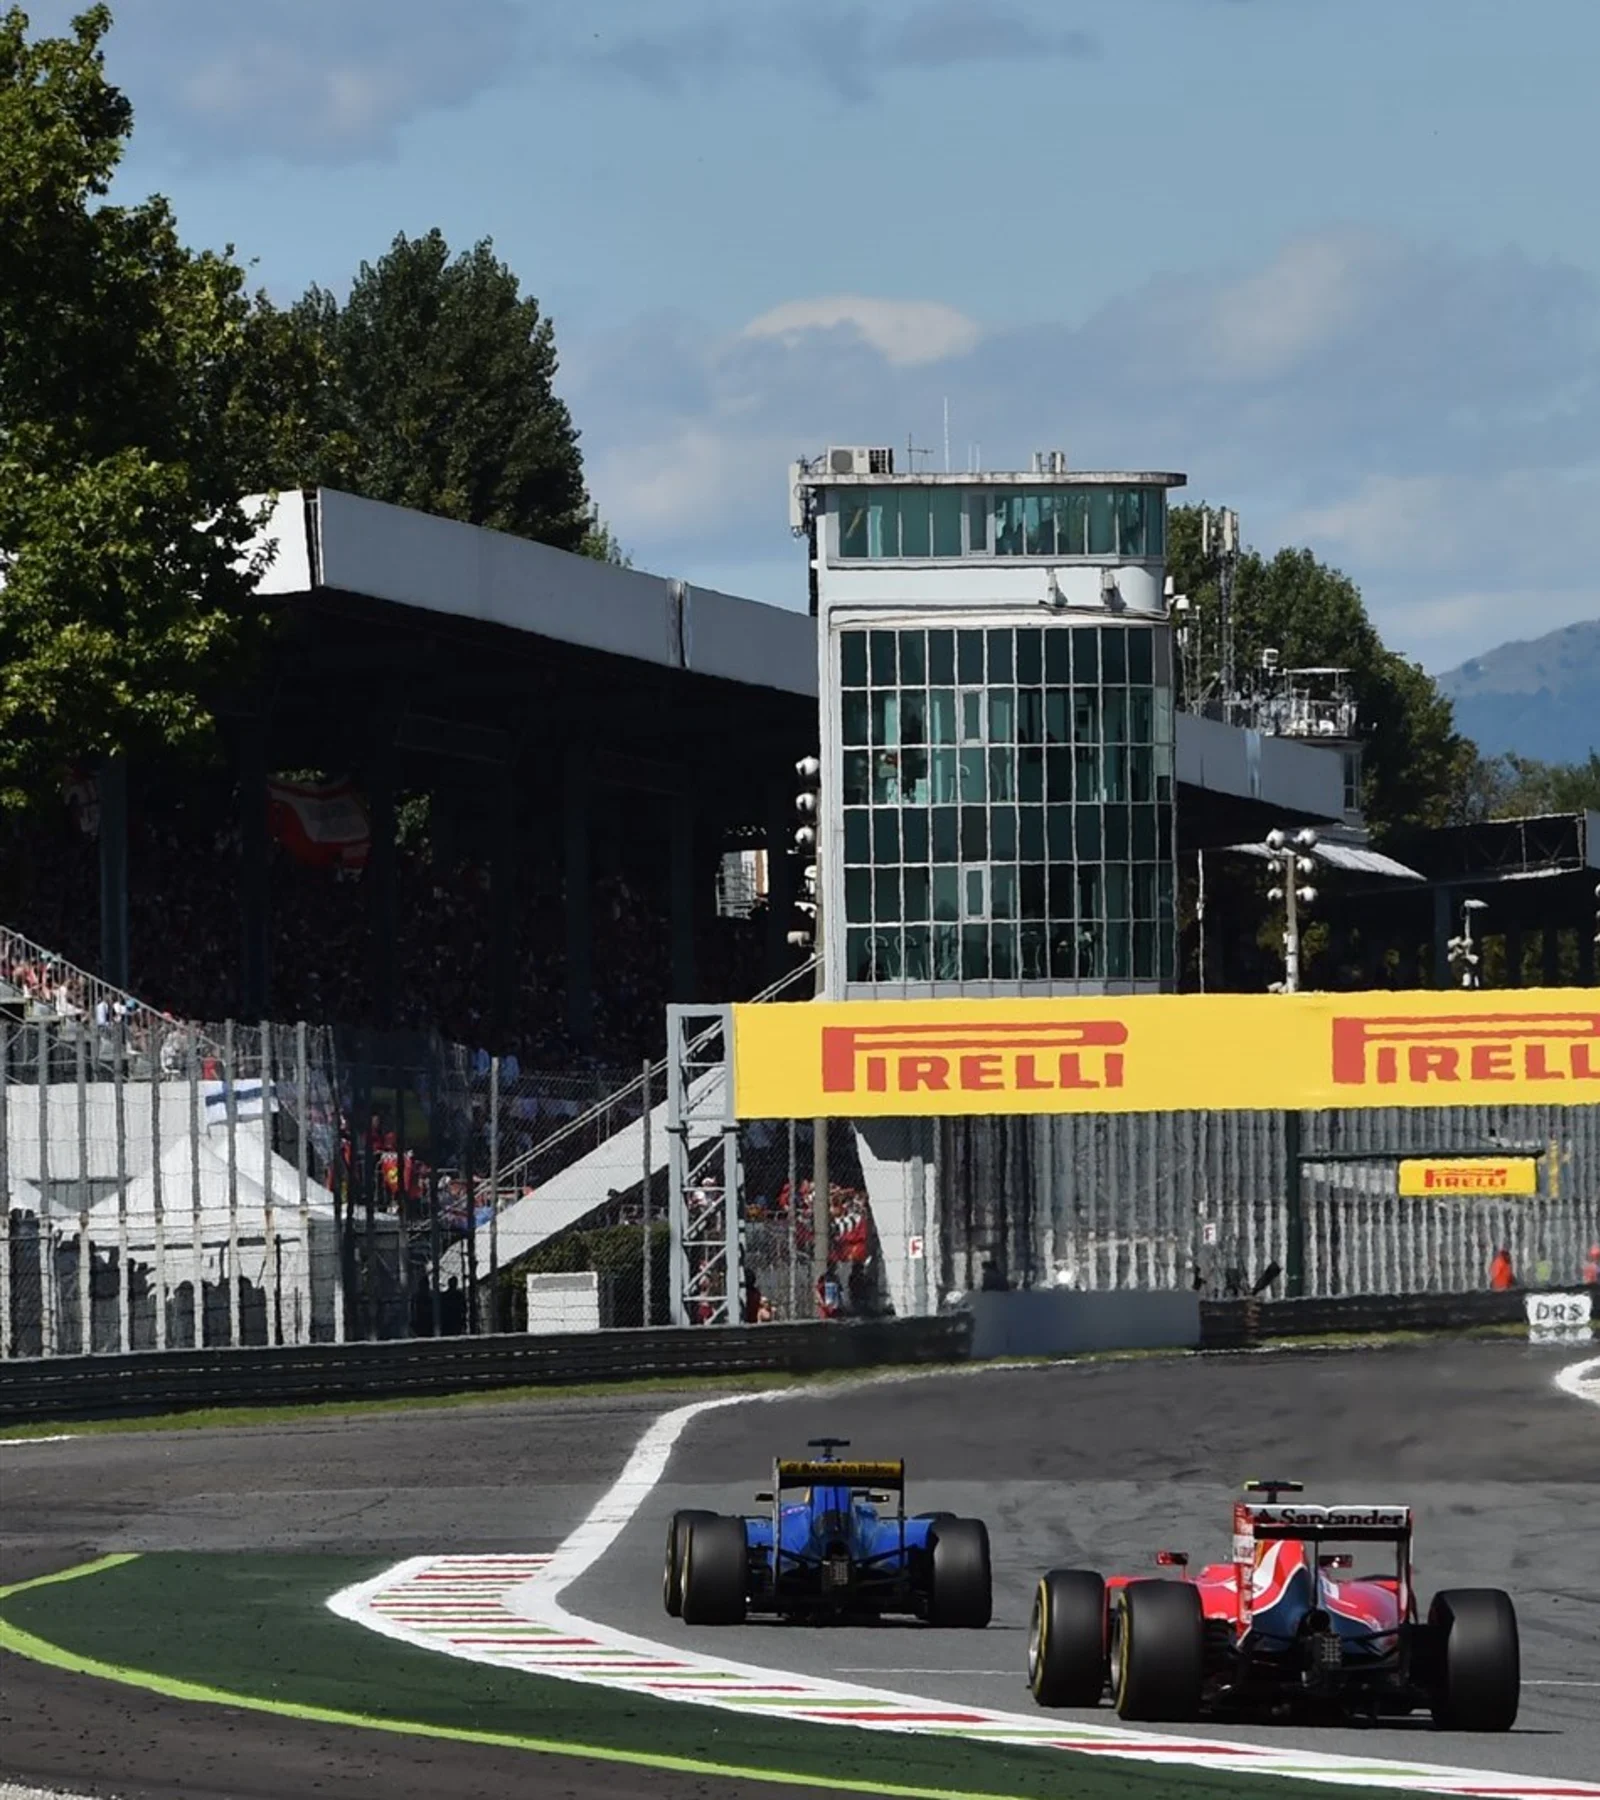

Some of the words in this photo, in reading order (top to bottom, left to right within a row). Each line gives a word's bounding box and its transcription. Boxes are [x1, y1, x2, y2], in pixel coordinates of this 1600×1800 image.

[823, 1021, 1128, 1092] PIRELLI
[1424, 1168, 1507, 1189] PIRELLI
[1280, 1508, 1403, 1526] Santander
